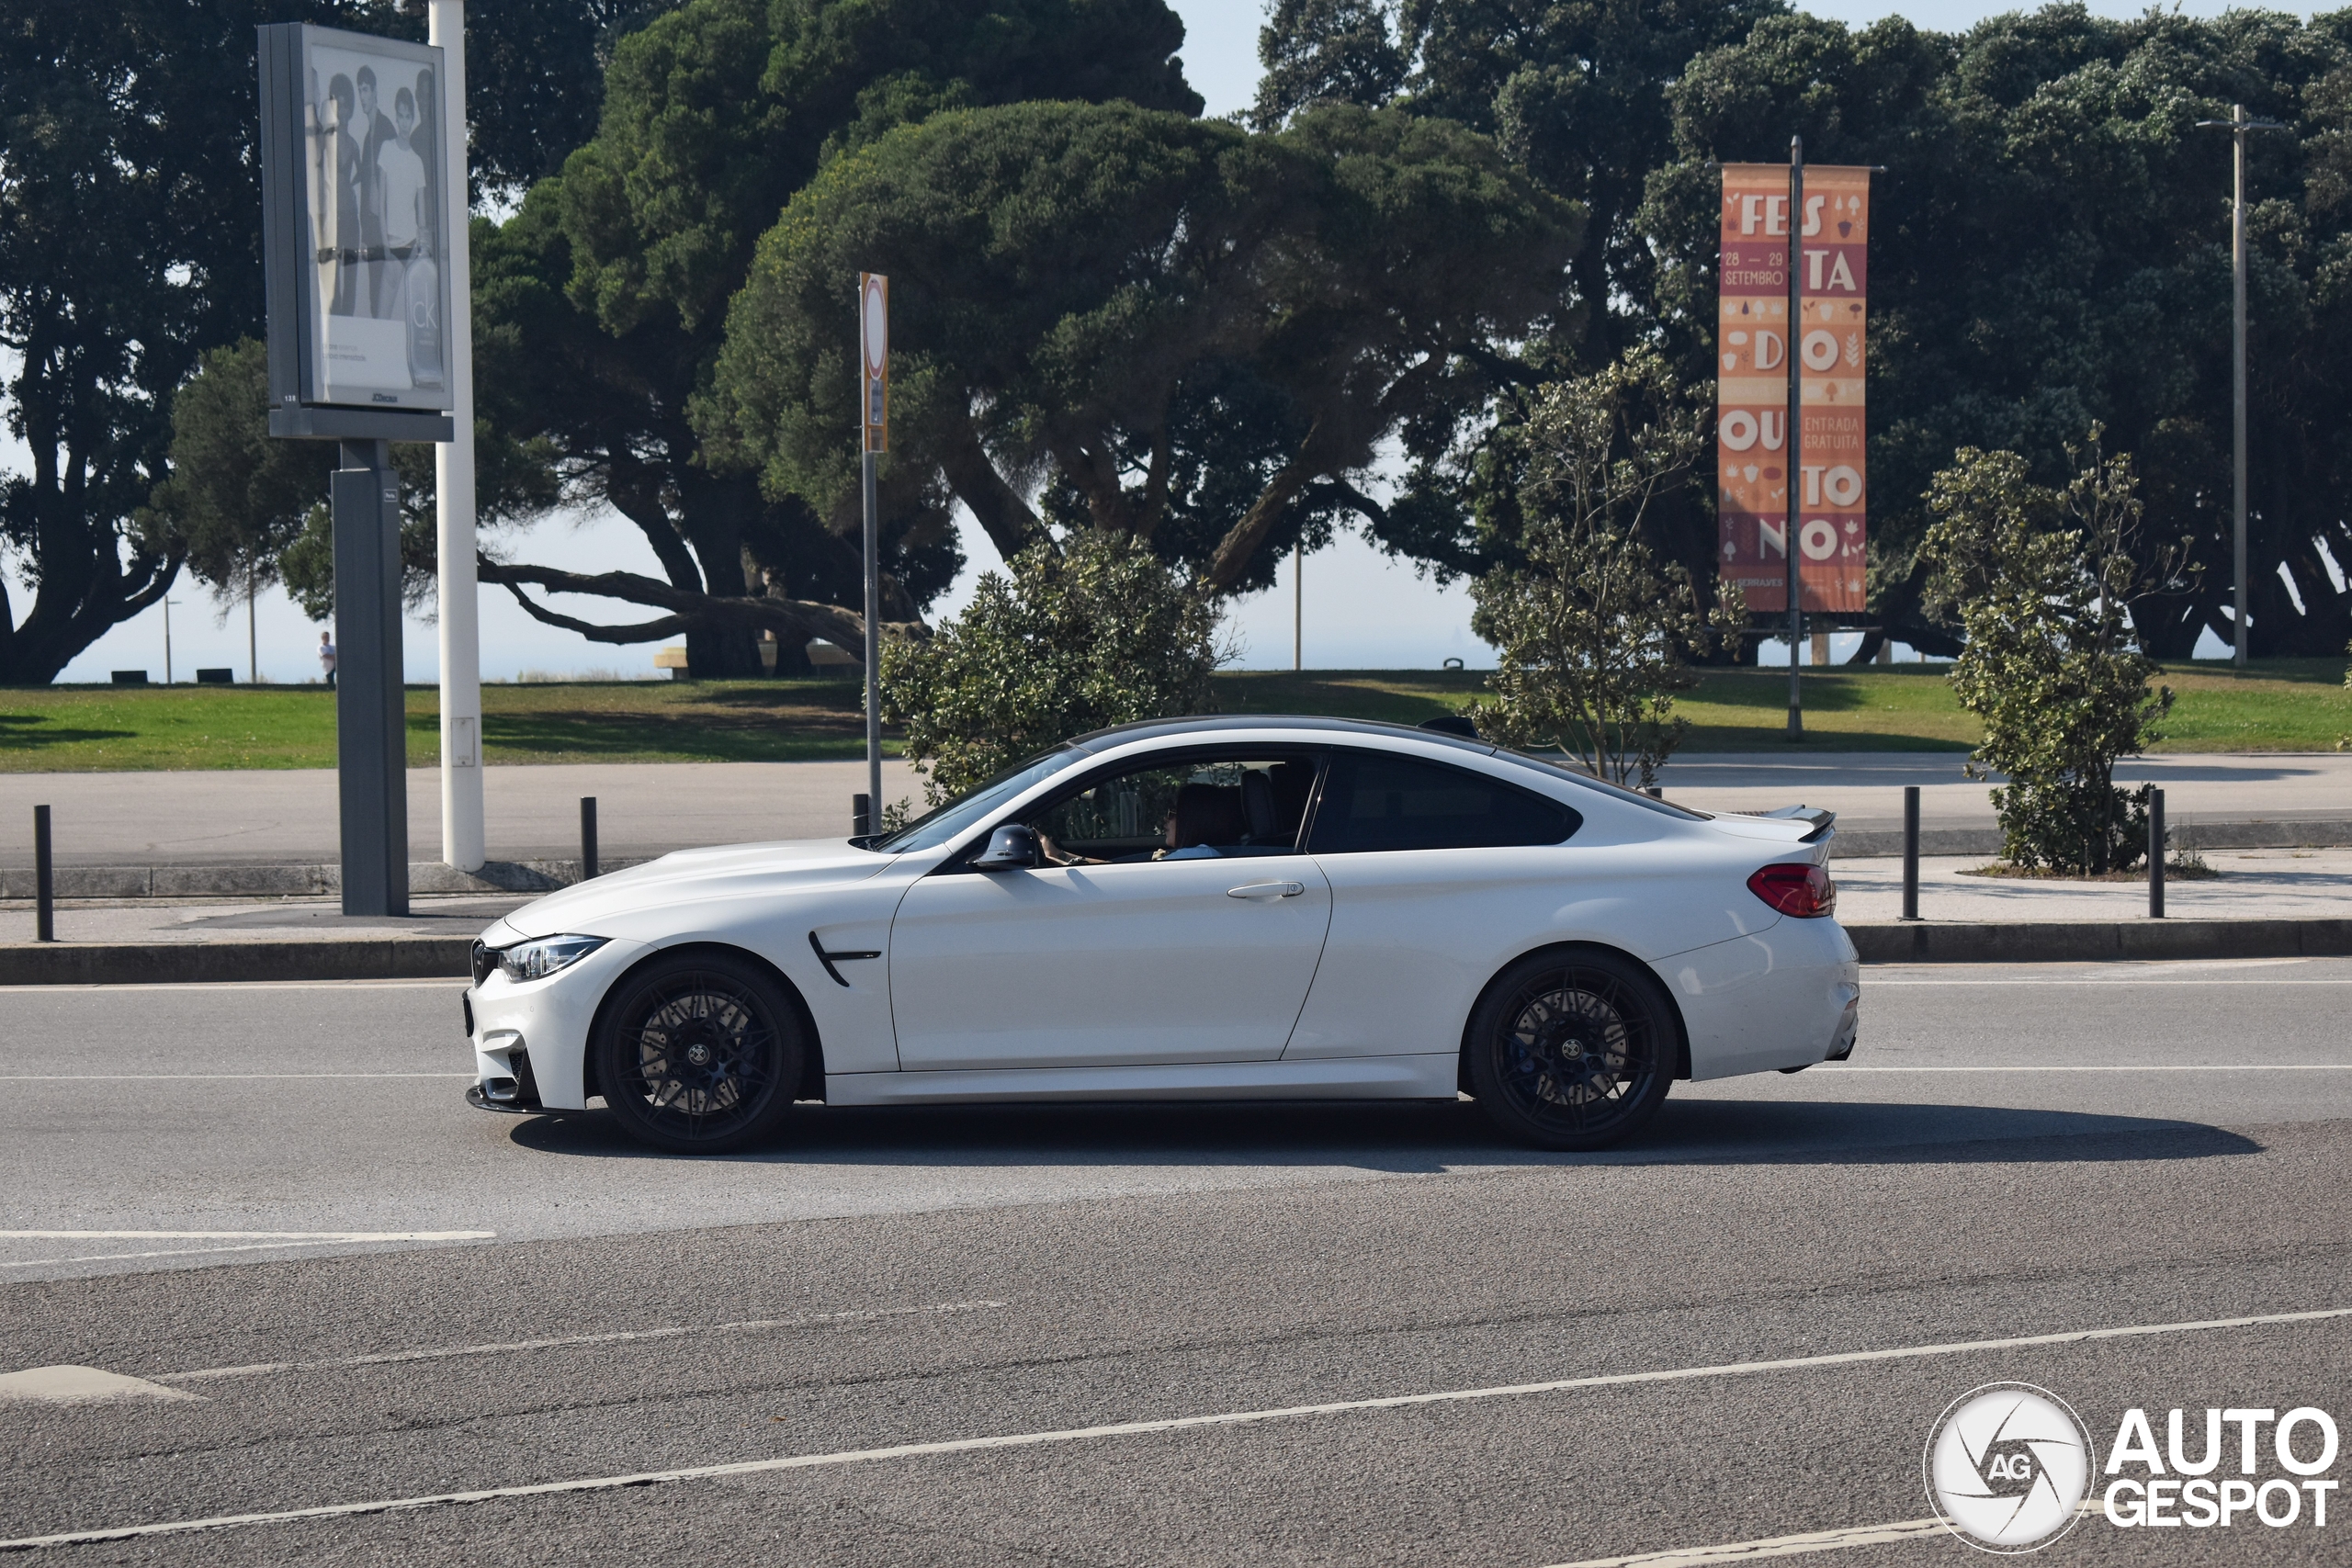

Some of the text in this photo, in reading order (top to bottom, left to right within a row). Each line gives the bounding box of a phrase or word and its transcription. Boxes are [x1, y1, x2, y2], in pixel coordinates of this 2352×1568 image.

[1725, 252, 1740, 266] 28
[1769, 252, 1783, 266] 29
[1725, 270, 1783, 286] SETEMBRO
[1804, 250, 1856, 291] TA
[371, 393, 398, 403] JCDecaux
[1719, 410, 1784, 451] OU
[1804, 417, 1859, 432] ENTRADA
[1804, 434, 1859, 449] GRATUITA
[1801, 465, 1862, 507] TO
